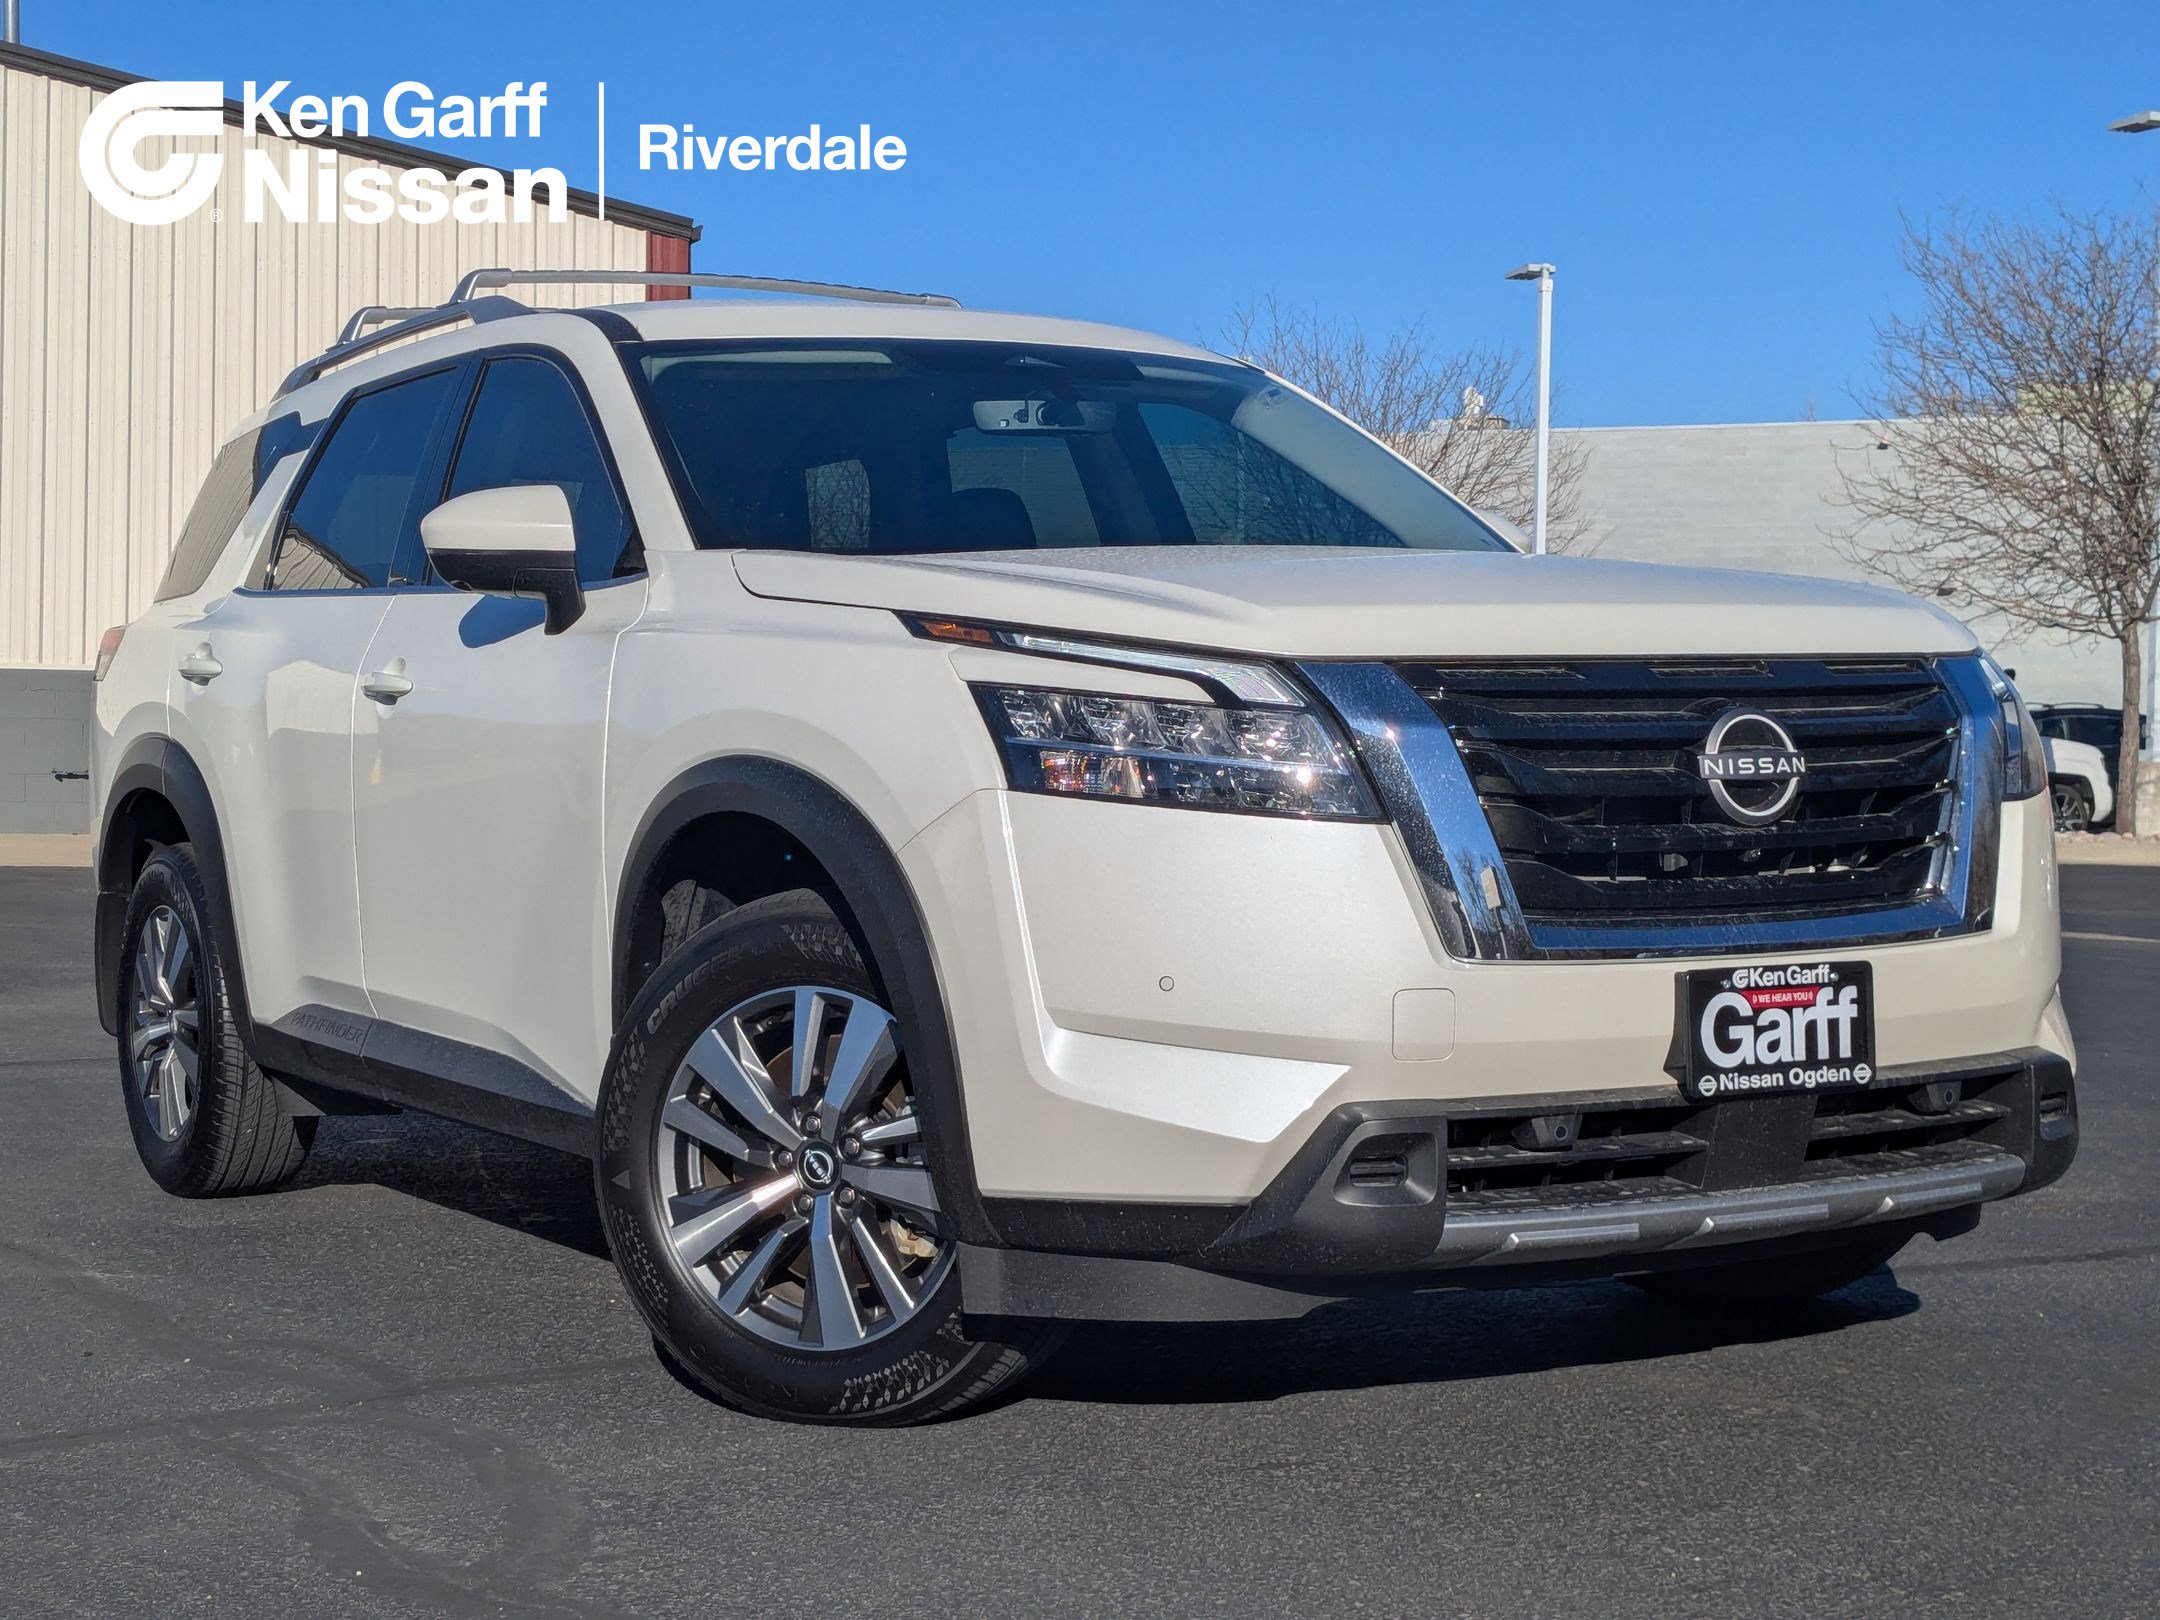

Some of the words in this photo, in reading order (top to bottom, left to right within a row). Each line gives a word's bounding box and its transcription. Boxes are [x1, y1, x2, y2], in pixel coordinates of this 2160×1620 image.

[1703, 756, 1806, 776] NISSAN
[1749, 967, 1786, 988] Ken
[1786, 963, 1830, 986] Garff
[1758, 993, 1771, 1004] WE
[1771, 991, 1792, 1003] HEAR
[1793, 990, 1808, 1002] YOU
[291, 1012, 364, 1044] PATHFINDER
[1700, 984, 1859, 1069] Garff
[1719, 1071, 1784, 1091] Nissan
[1788, 1065, 1851, 1089] Ogden
